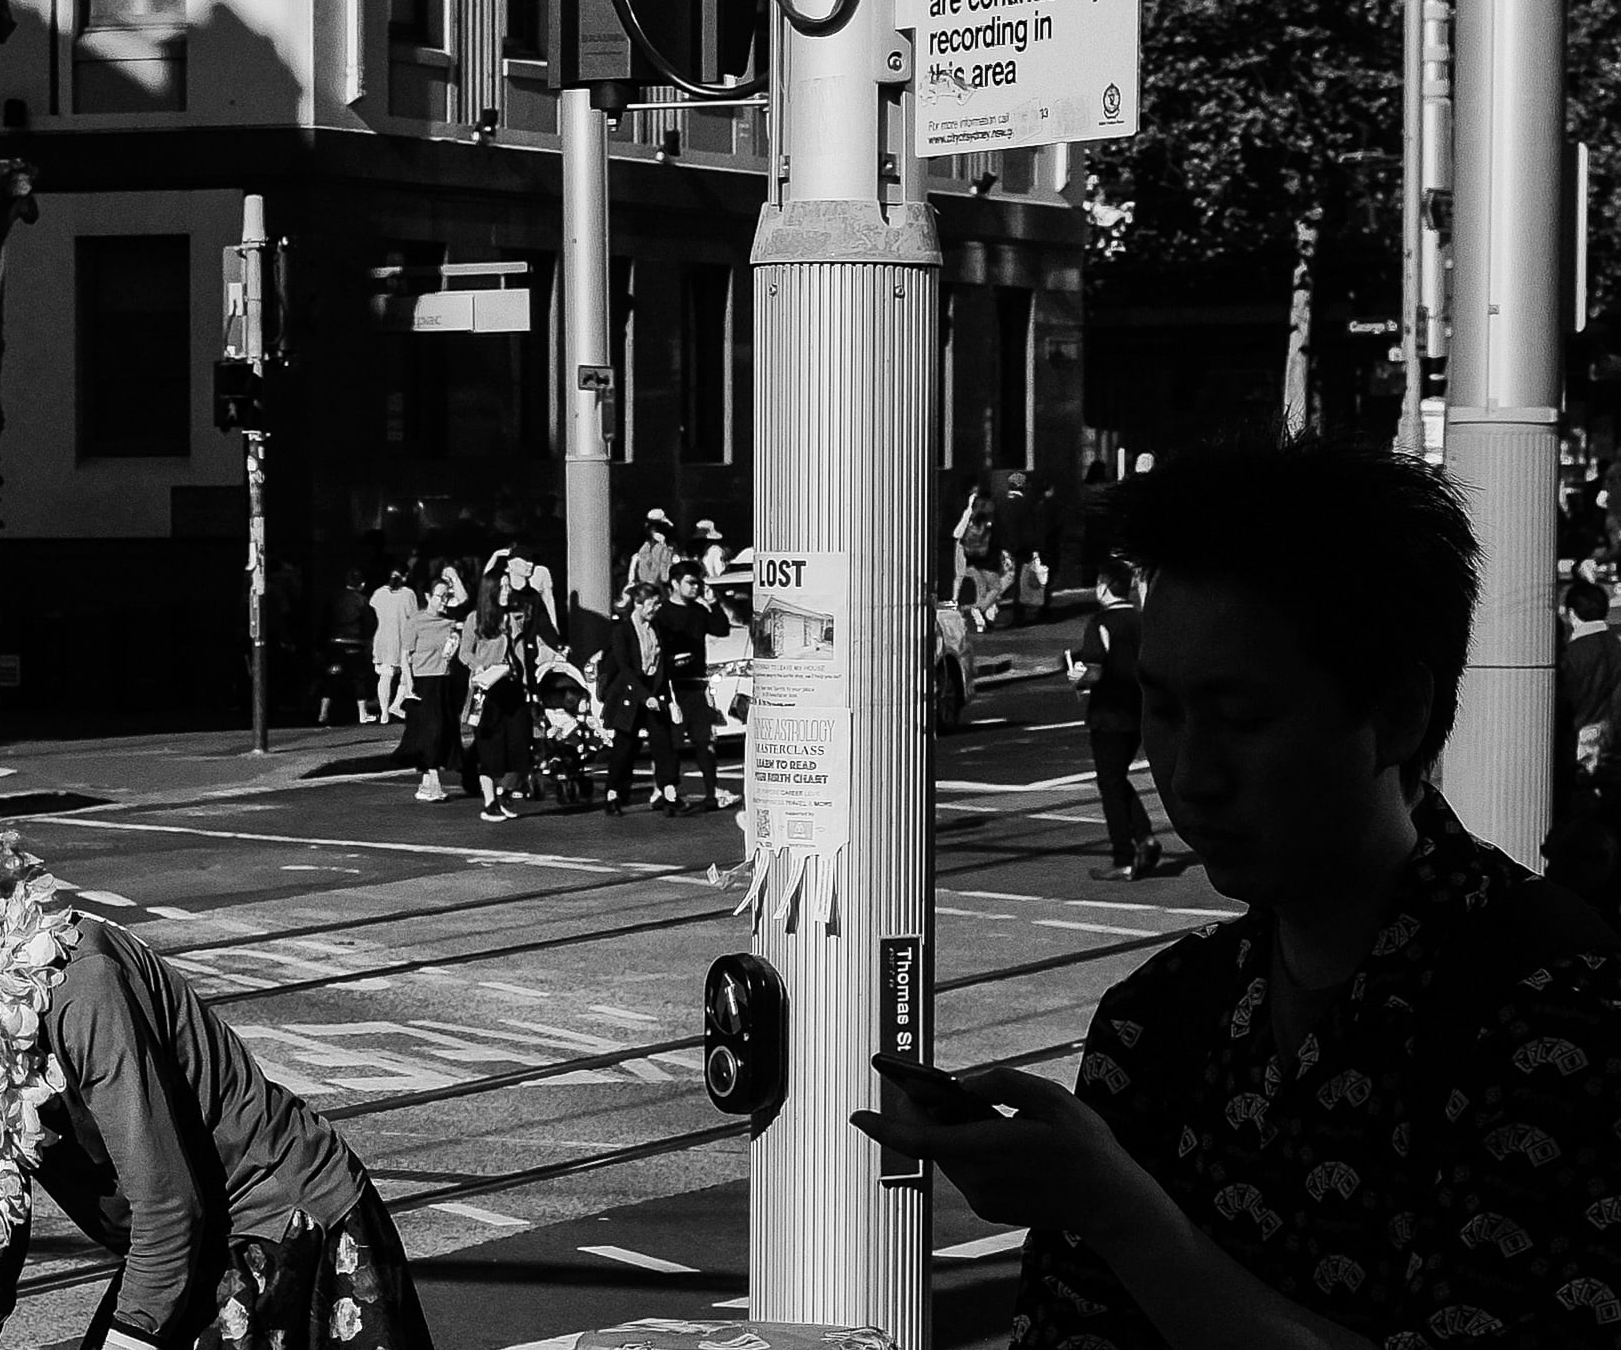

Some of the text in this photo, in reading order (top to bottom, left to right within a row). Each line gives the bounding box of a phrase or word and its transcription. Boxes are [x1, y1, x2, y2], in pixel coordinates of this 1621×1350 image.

[929, 9, 1053, 56] recording in
[970, 59, 1017, 88] area
[758, 559, 807, 588] LOST
[773, 718, 836, 743] ASTROLOGY
[776, 759, 788, 770] TO
[789, 760, 817, 771] READ
[793, 773, 829, 785] CHART
[896, 946, 913, 1053] Thomas St
